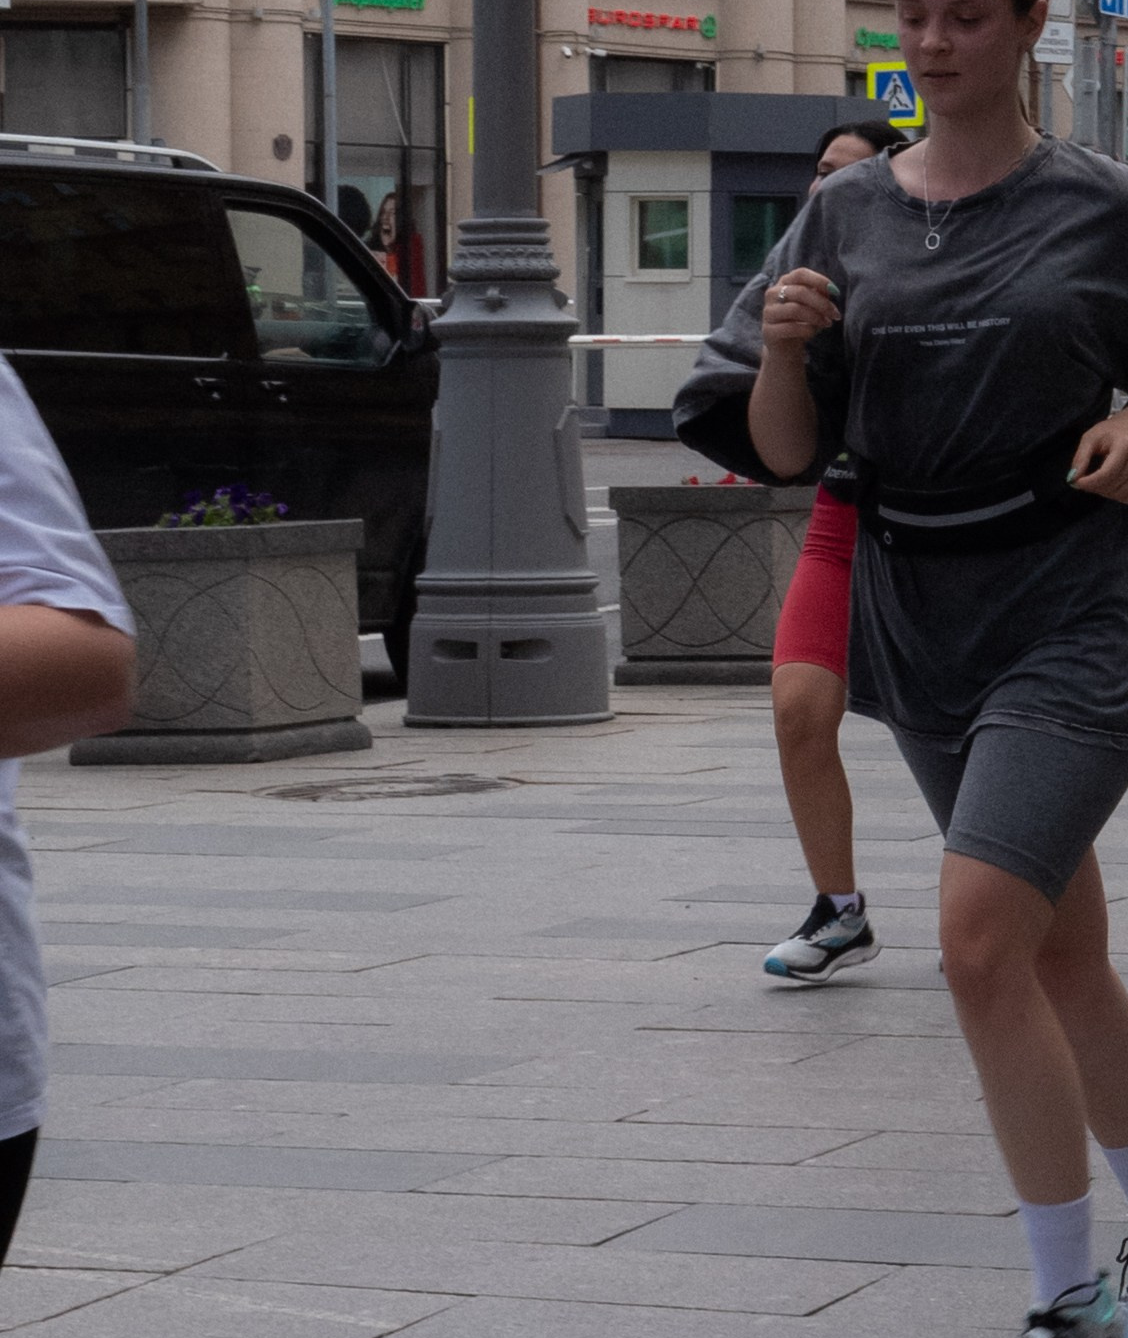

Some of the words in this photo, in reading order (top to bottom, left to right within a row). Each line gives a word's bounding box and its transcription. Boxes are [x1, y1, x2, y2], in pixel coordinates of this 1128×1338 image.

[904, 325, 926, 333] EVEN
[927, 323, 946, 332] THIS
[946, 322, 965, 330] WILL
[978, 317, 1011, 328] HISTORY
